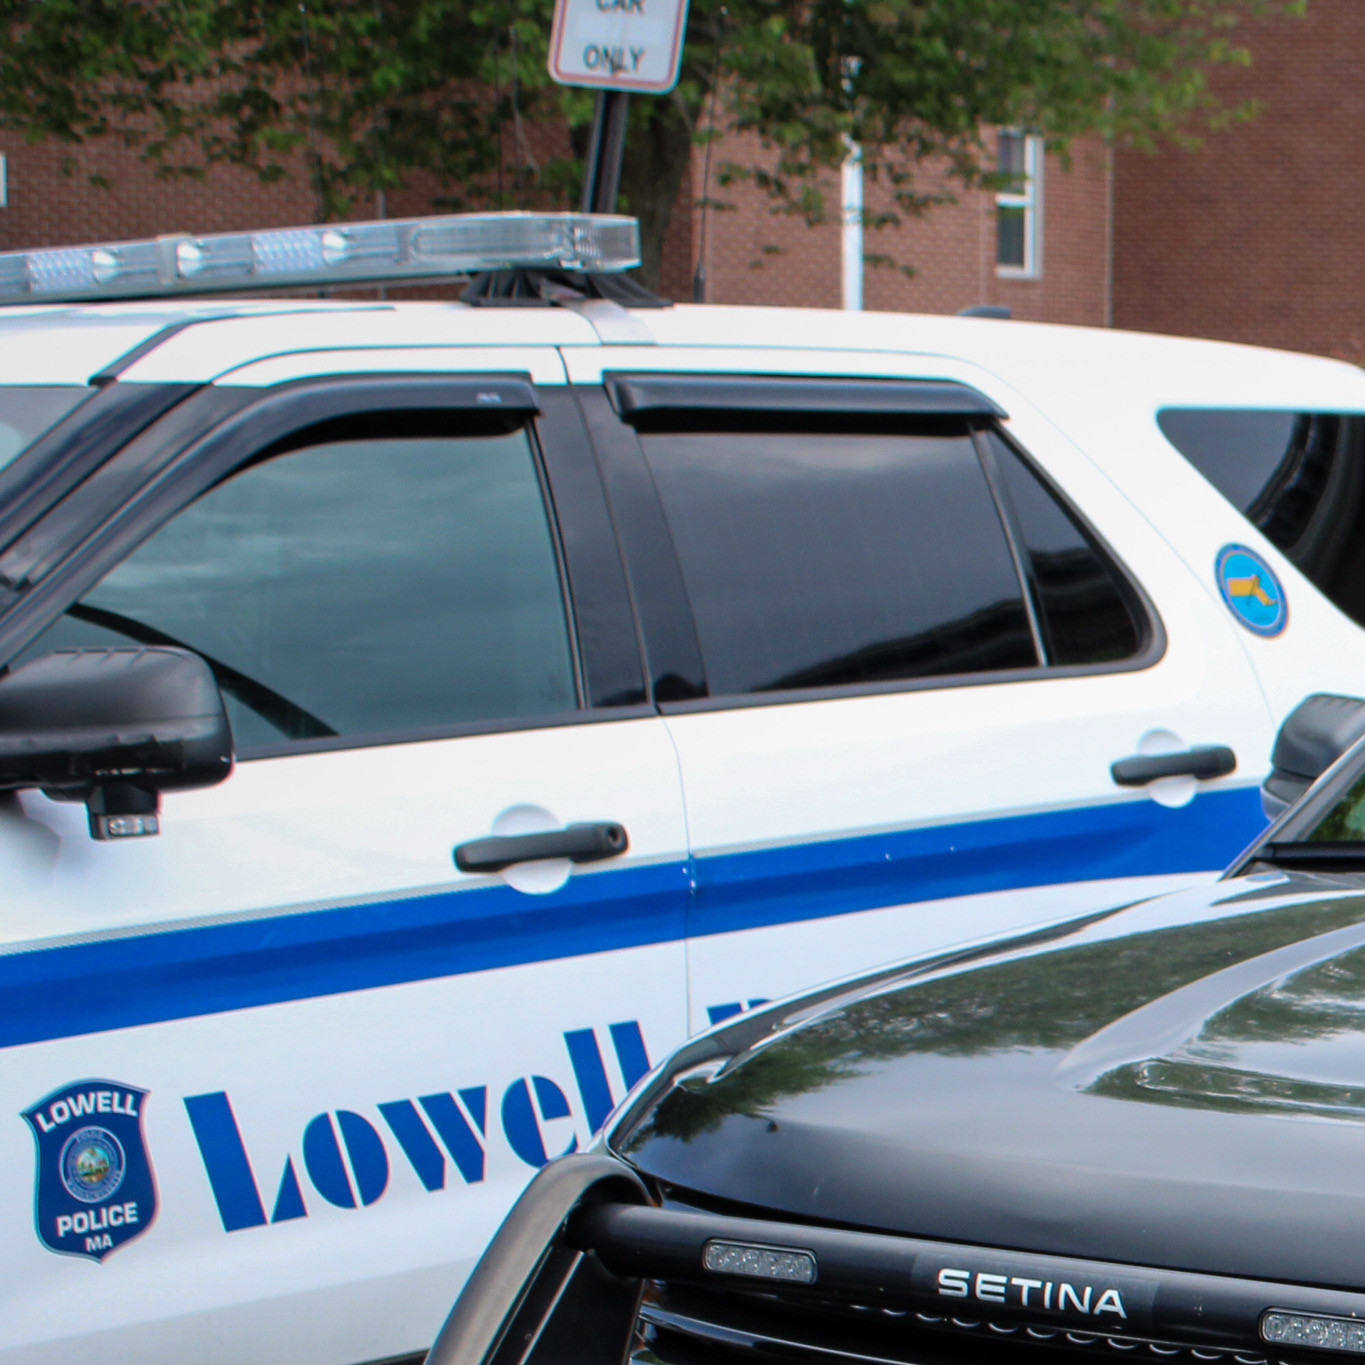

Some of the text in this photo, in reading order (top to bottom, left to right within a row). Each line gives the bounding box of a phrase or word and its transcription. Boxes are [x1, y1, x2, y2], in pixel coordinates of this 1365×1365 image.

[582, 43, 645, 72] ONLY
[34, 1090, 139, 1134] LOWELL
[55, 1201, 140, 1238] POLICE
[85, 1233, 115, 1253] MA
[937, 1267, 1128, 1320] SETINA
